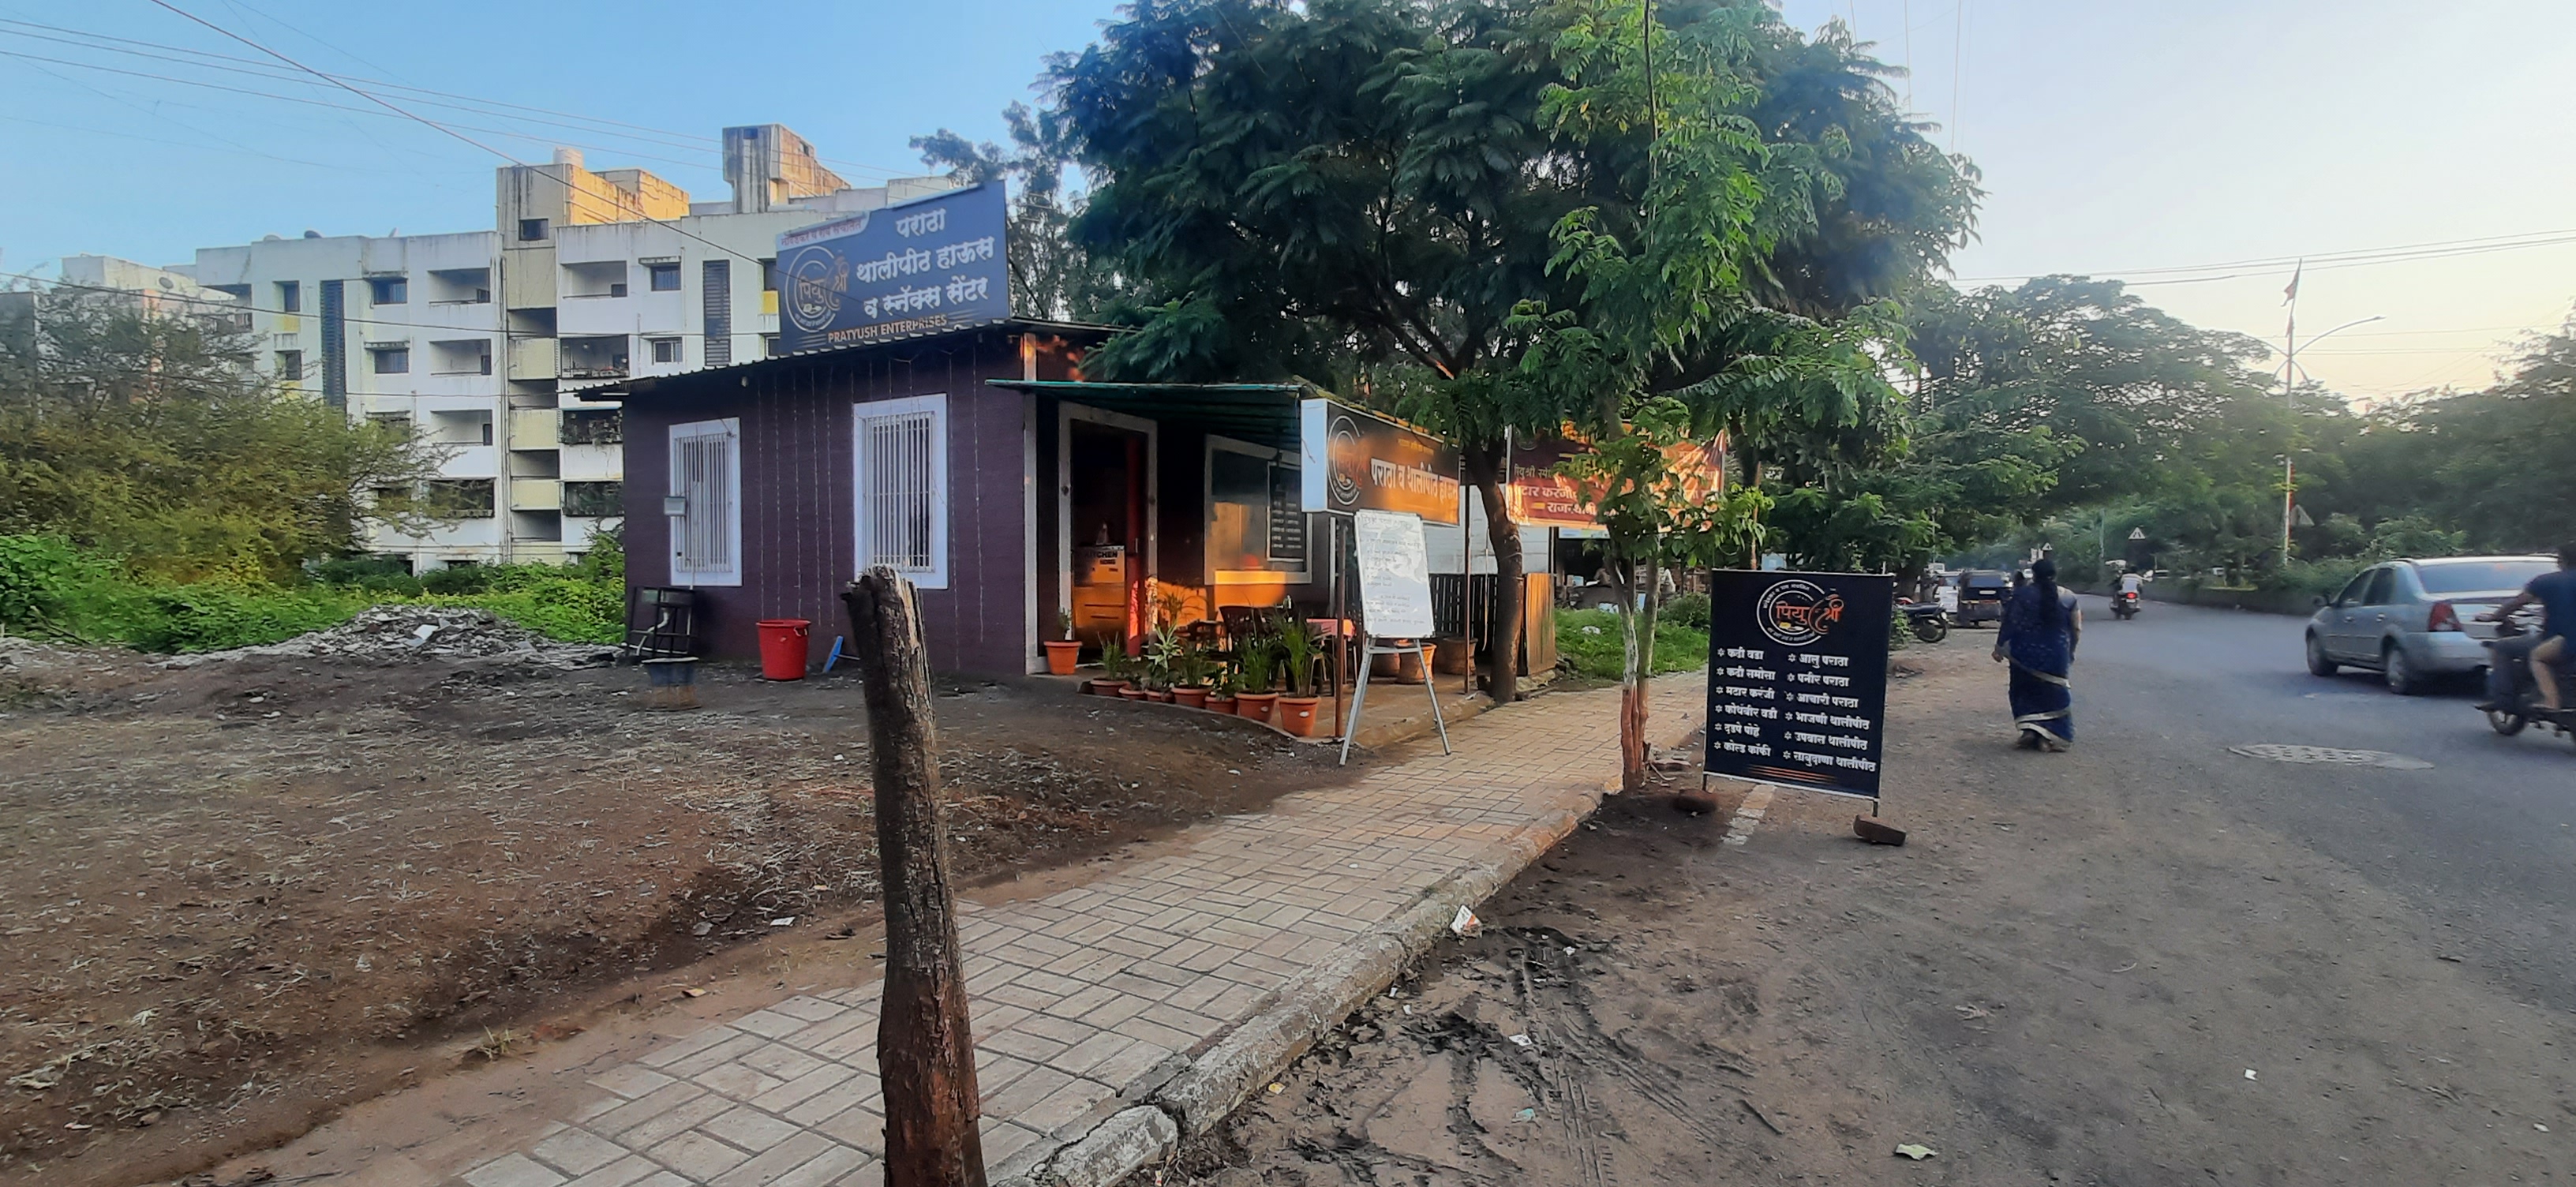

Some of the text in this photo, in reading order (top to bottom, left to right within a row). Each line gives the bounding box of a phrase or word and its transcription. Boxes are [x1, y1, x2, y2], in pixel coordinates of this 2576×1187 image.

[896, 208, 946, 238] पराठा
[856, 236, 994, 283] थालीपीठ हाऊस
[863, 298, 878, 319] व
[882, 285, 942, 316] स्नॅक्स
[945, 275, 988, 305] सेंटर
[828, 314, 947, 343] PRATYUSH ENTERPRISES
[1371, 457, 1397, 489] पराठा
[1398, 465, 1406, 491] व
[1407, 462, 1439, 498] थालीपीठ
[1520, 484, 1539, 497] टार
[1776, 600, 1810, 625] पियु
[1747, 650, 1764, 660] वडा
[1799, 653, 1849, 668] आलु पराठा
[1746, 666, 1776, 680] समोसा
[1797, 671, 1850, 687] पनीर पराठा
[1725, 686, 1775, 699] मटार करंजी
[1796, 692, 1859, 708] आचारी पराठा
[1760, 706, 1777, 719] वडी
[1795, 712, 1870, 730] भाजणी थालीपीठ
[1743, 722, 1760, 738] पोहे
[1723, 739, 1746, 754] कोल्ड
[1794, 732, 1868, 751] उपवास थालीपीठ
[1836, 756, 1876, 772] थालीपीठ
